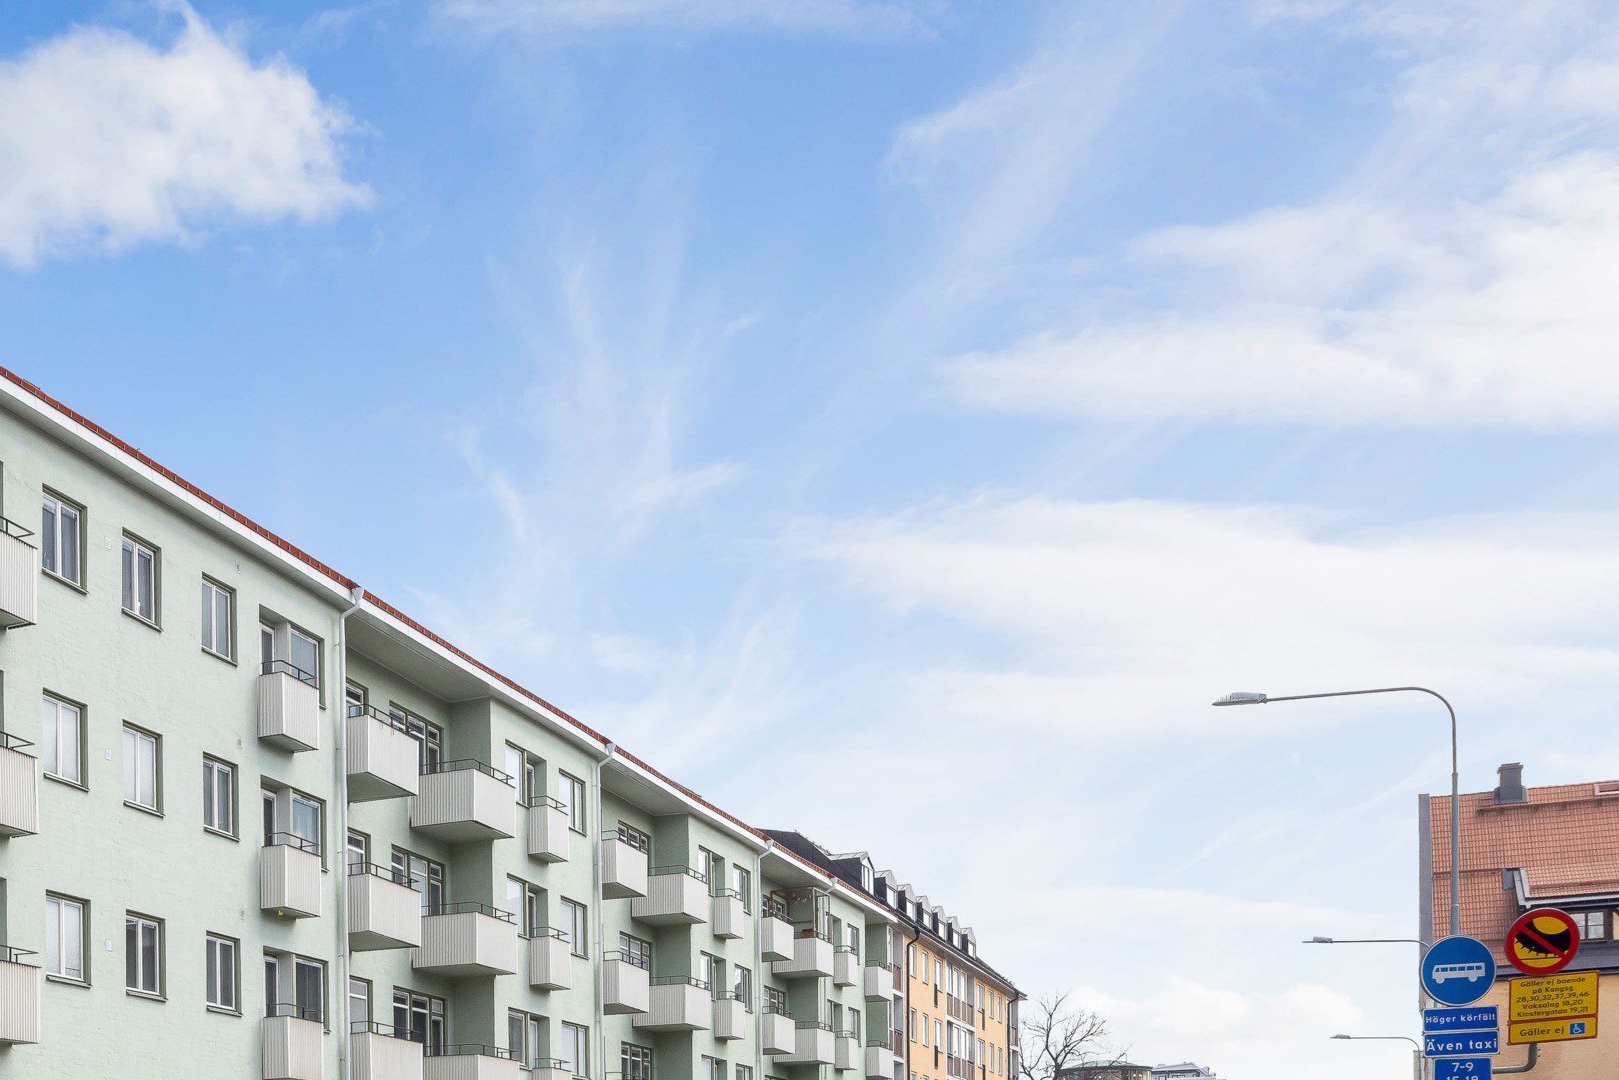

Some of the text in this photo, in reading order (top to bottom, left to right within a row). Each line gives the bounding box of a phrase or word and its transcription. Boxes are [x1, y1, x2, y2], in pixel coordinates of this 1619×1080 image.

[1557, 977, 1586, 985] boende
[1532, 986, 1574, 995] på Kungsg
[1522, 999, 1583, 1010] Vaksalag 18,20
[1517, 1008, 1567, 1018] Klostergatan
[1426, 1013, 1495, 1024] Höger körfält
[1520, 1026, 1564, 1036] Gäller ej
[1426, 1038, 1497, 1052] Även taxi
[1451, 1062, 1474, 1072] 7-9
